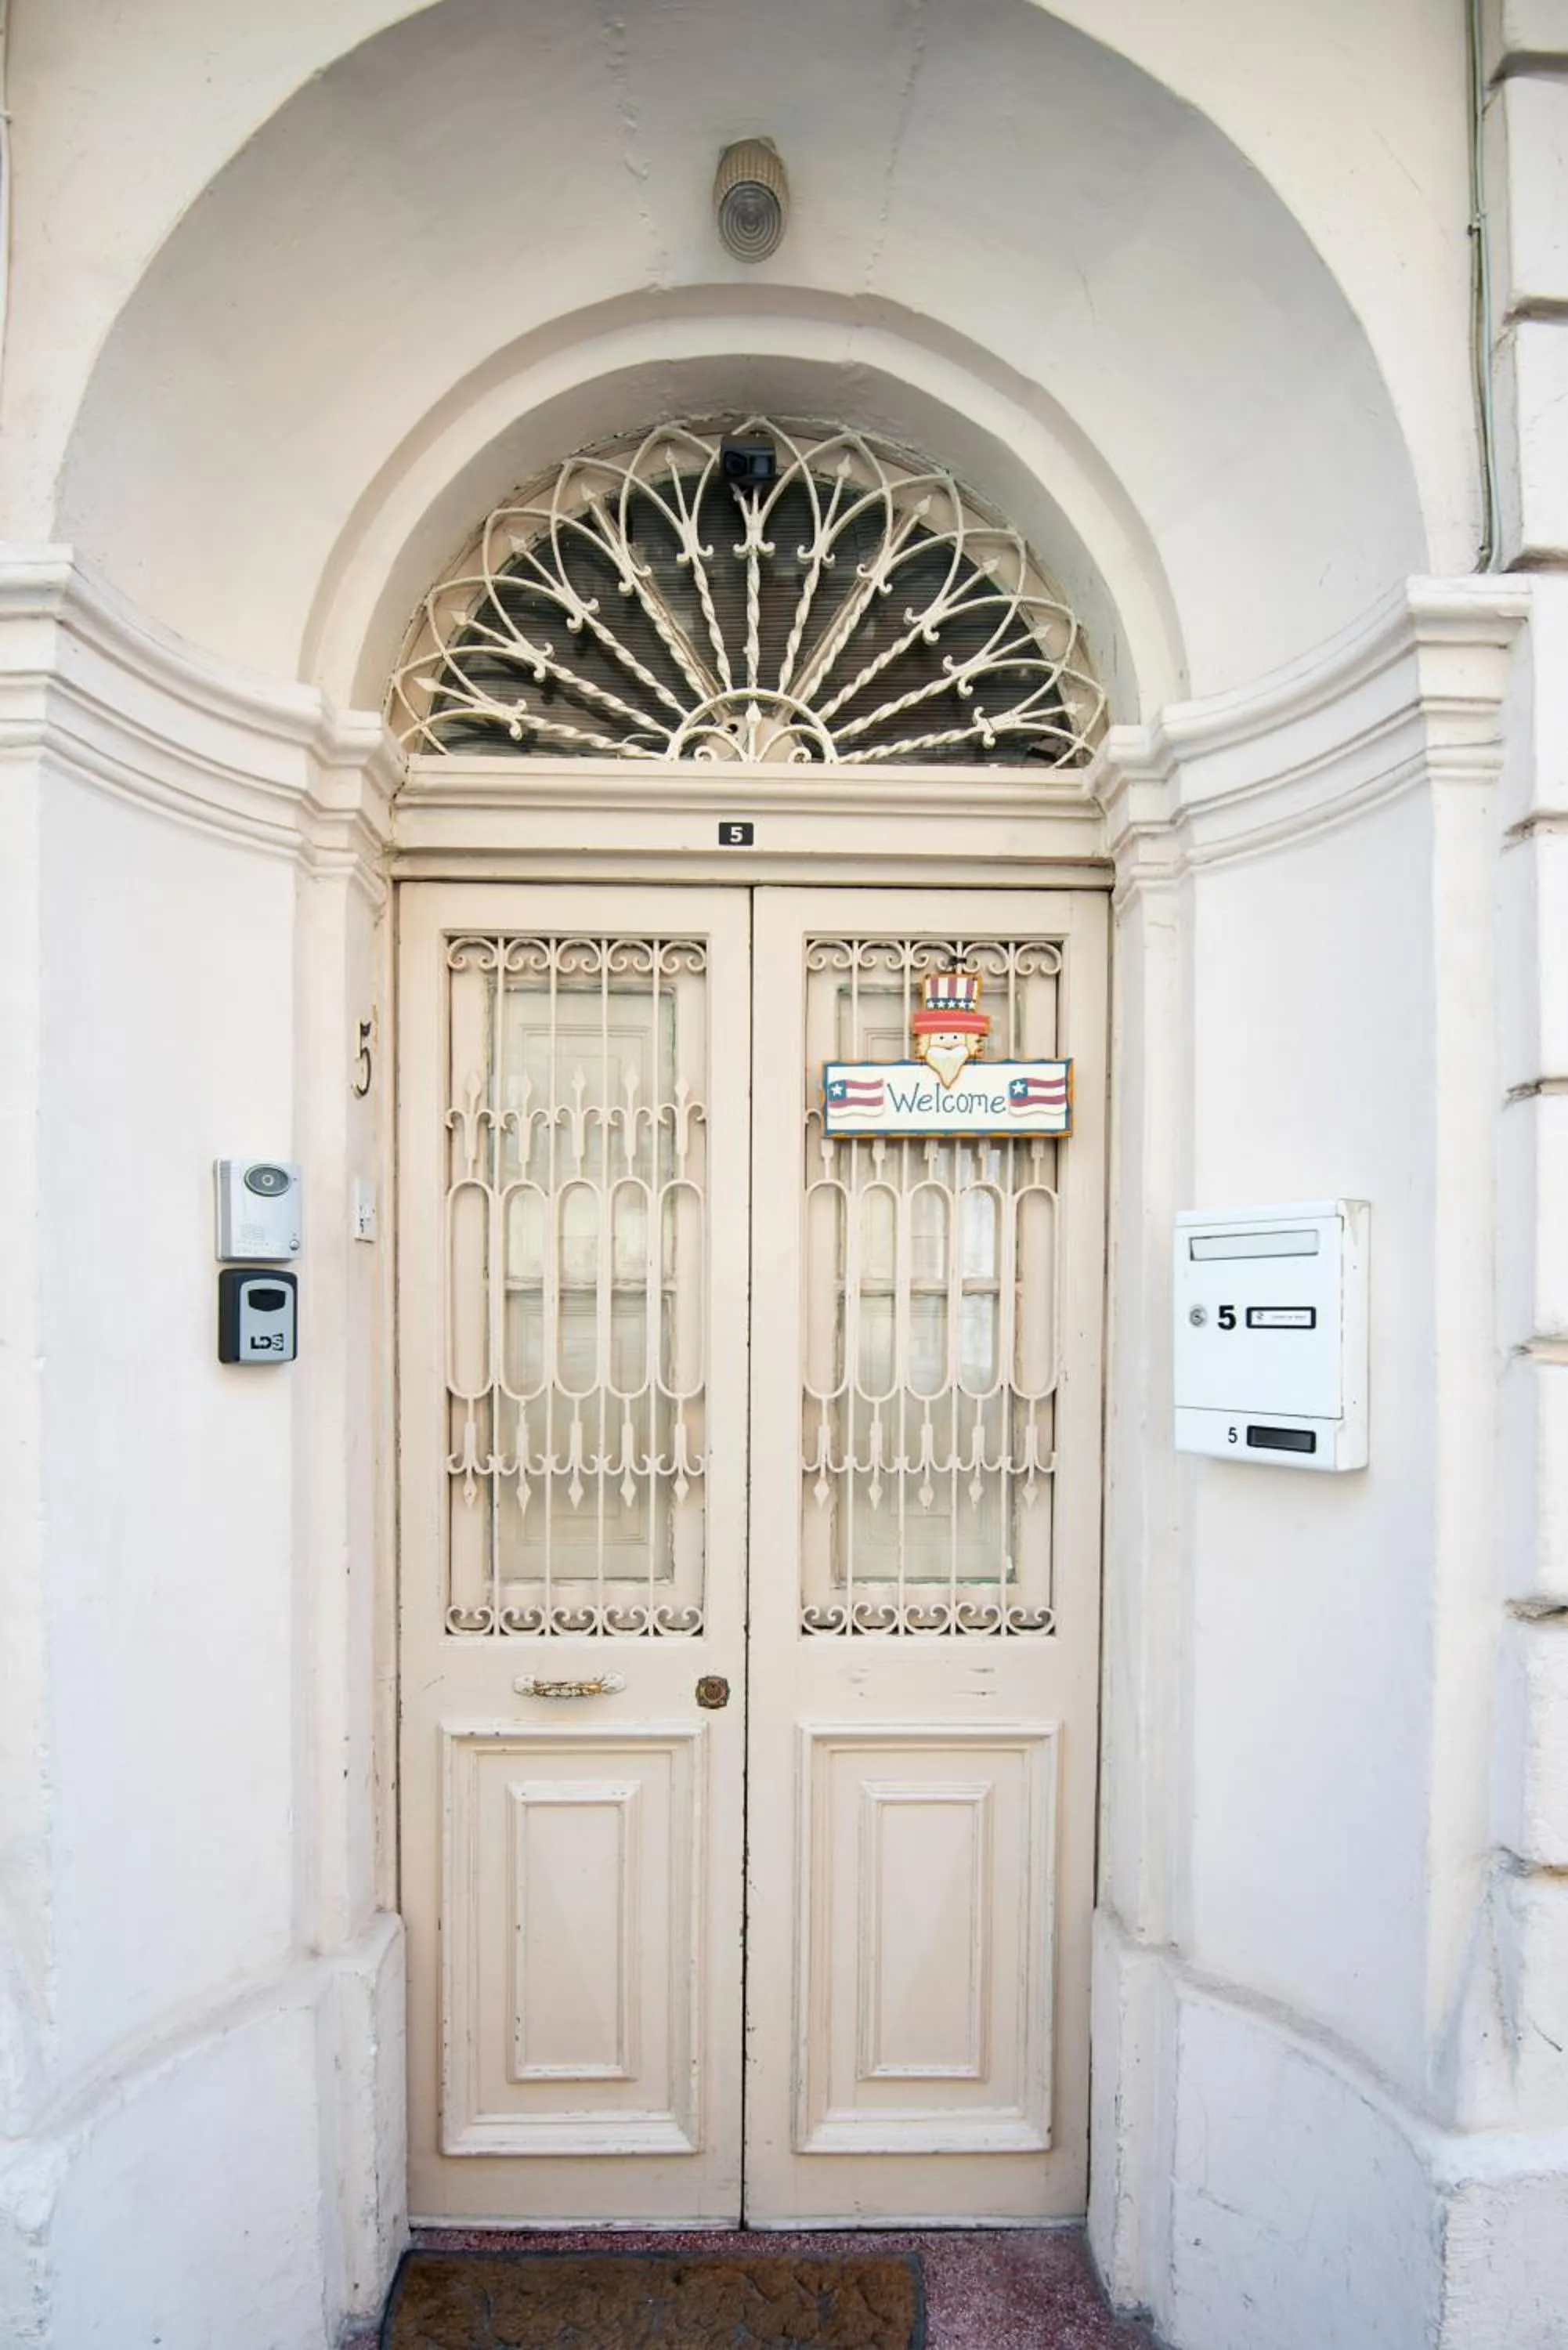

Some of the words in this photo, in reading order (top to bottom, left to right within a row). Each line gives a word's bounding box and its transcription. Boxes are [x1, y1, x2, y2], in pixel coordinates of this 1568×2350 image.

[730, 826, 743, 843] 5
[352, 1020, 372, 1099] 5
[887, 1082, 1006, 1114] Welcome
[1217, 1304, 1237, 1331] 5
[251, 1332, 284, 1351] LDS
[1227, 1426, 1238, 1444] 5
